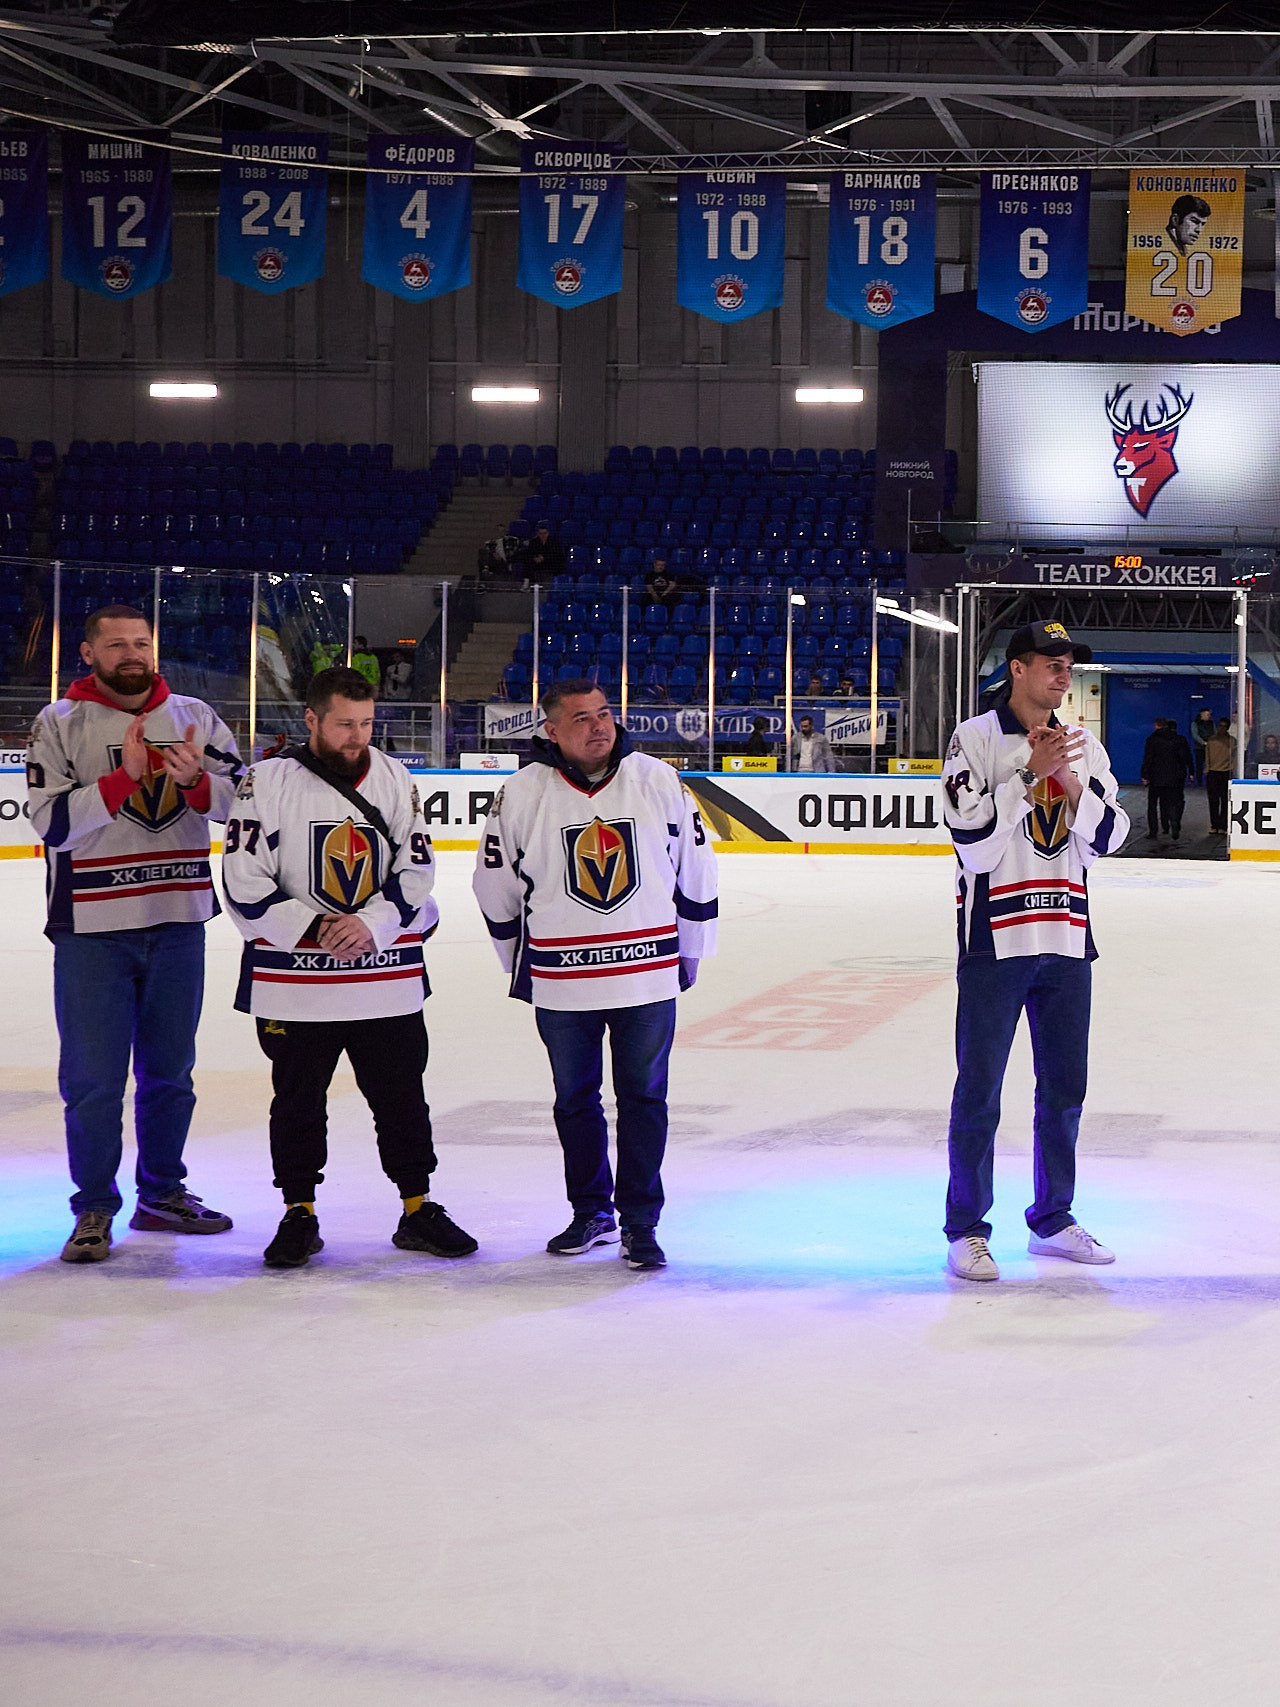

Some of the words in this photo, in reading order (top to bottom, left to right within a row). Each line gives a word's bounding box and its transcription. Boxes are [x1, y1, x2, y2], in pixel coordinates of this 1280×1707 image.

[88, 144, 142, 159] МИШИН
[232, 144, 317, 160] КОВАЛЕНКО
[385, 143, 456, 164] ФЁДОРОВ
[534, 151, 611, 170] СКВОРЦОВ
[80, 170, 110, 183] 1965
[123, 170, 153, 182] 1980
[239, 167, 267, 179] 1988
[279, 168, 309, 180] 2008
[844, 173, 921, 189] ВАРНАКОВ
[992, 173, 1079, 191] ПРЕСНЯКОВ
[539, 177, 566, 189] 1972
[579, 178, 607, 191] 1989
[1136, 176, 1237, 193] КОНОВАЛЕНКО
[696, 193, 724, 206] 1972
[738, 194, 766, 206] 1988
[849, 199, 876, 211] 1976
[890, 199, 915, 211] 1991
[998, 201, 1028, 214] 1976
[1043, 202, 1072, 215] 1993
[87, 196, 146, 247] 12
[241, 190, 305, 236] 24
[400, 190, 430, 239] 4
[544, 194, 599, 244] 17
[702, 210, 759, 260] 10
[854, 215, 908, 265] 18
[1133, 235, 1162, 248] 1956
[1209, 236, 1238, 250] 1972
[1019, 227, 1049, 279] 6
[1151, 250, 1213, 297] 20
[890, 460, 930, 469] НИЖНИЙ
[886, 470, 934, 479] НОВГОРОД
[1114, 555, 1142, 569] 15:00
[1034, 563, 1111, 583] ТЕАТР
[1117, 565, 1217, 585] ХОККЕЯ
[226, 818, 261, 856] 97
[692, 812, 705, 846] 5
[484, 834, 503, 868] 5
[111, 869, 137, 884] ХК
[141, 864, 200, 880] ЛЕГИОН
[292, 955, 319, 969] ХК
[560, 951, 584, 966] ХК
[587, 943, 657, 964] ЛЕГИОН
